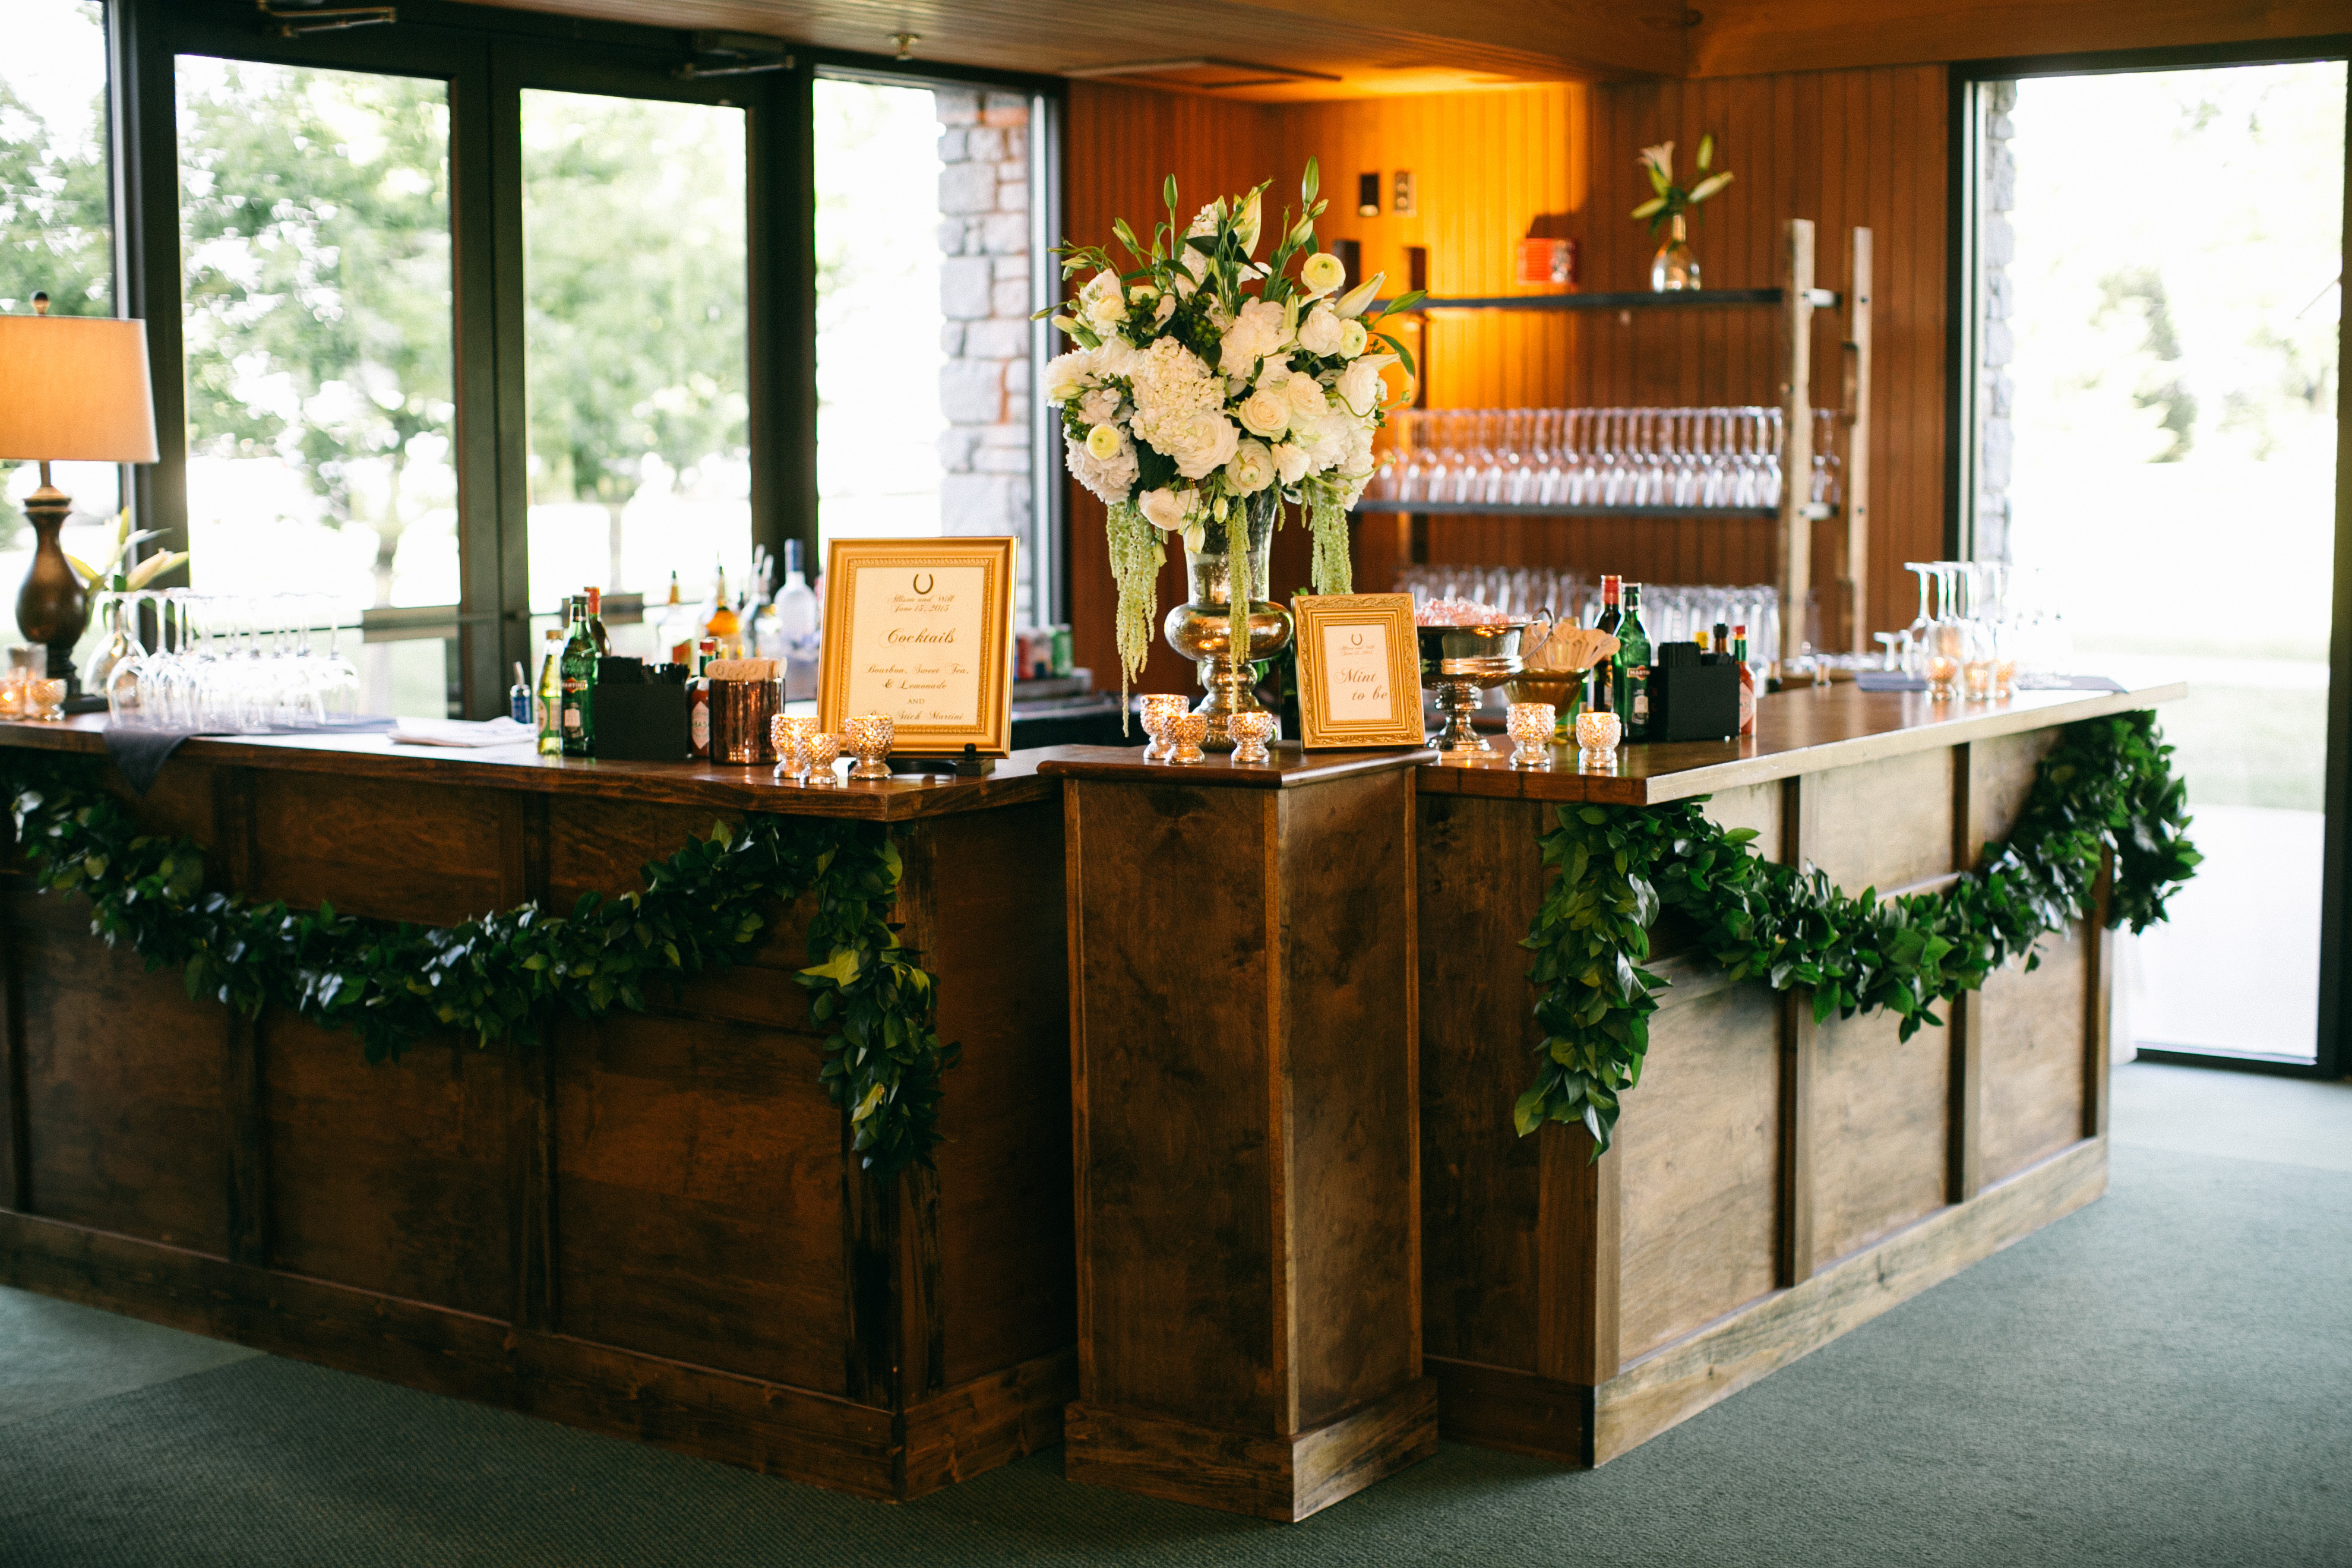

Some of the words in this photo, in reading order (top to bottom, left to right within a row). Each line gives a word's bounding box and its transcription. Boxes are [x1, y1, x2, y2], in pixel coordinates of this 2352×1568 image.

[892, 604, 912, 613] June
[878, 628, 956, 648] Cocktails
[865, 664, 907, 674] Bourbon,
[915, 663, 939, 674] Sweet
[1334, 667, 1377, 684] Mint
[897, 679, 946, 689] Lemonade
[1352, 690, 1364, 701] to
[1373, 685, 1387, 700] be
[897, 710, 922, 720] Stick
[929, 710, 963, 720] Martini
